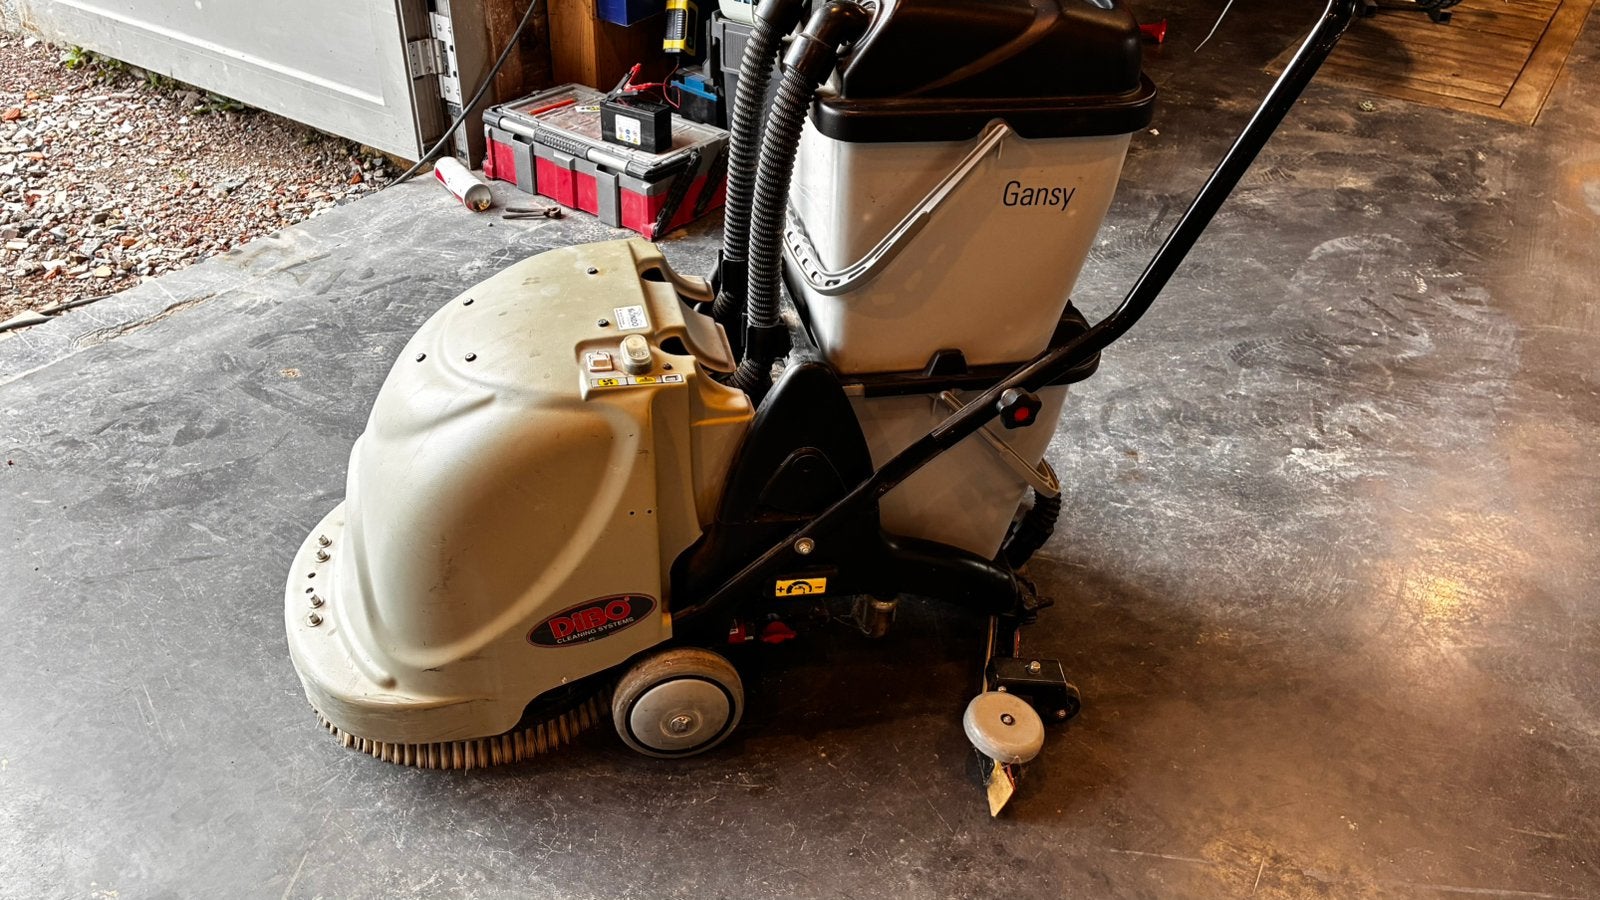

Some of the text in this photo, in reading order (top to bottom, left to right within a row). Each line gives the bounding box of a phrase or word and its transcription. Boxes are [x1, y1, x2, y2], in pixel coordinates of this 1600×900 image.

[1003, 180, 1076, 212] Gansy
[548, 599, 631, 639] DIBO
[556, 628, 597, 644] CLEANING
[598, 616, 635, 632] SYSTEMS
